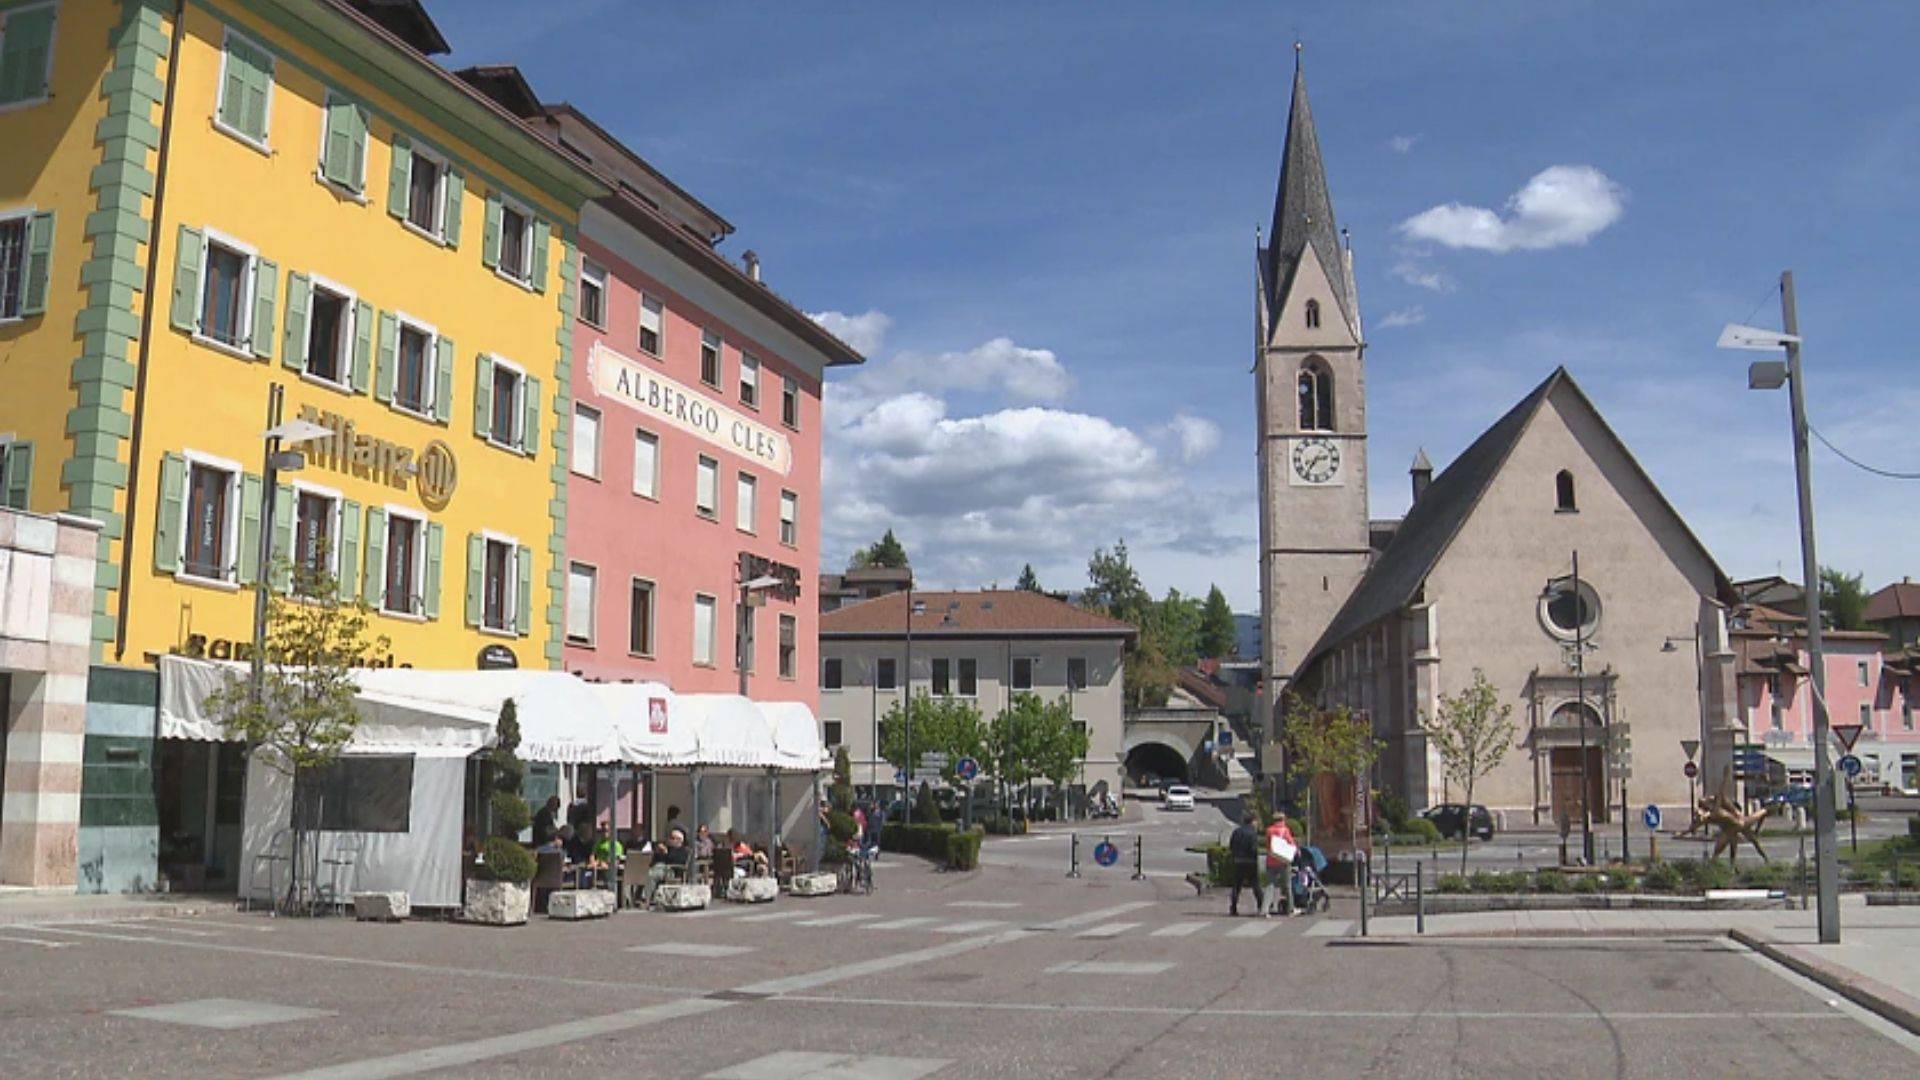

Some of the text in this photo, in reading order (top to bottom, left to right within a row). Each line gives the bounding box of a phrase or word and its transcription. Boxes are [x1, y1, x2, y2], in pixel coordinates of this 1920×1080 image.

[289, 403, 415, 492] Allianz
[616, 367, 777, 461] ALBERGO CLES
